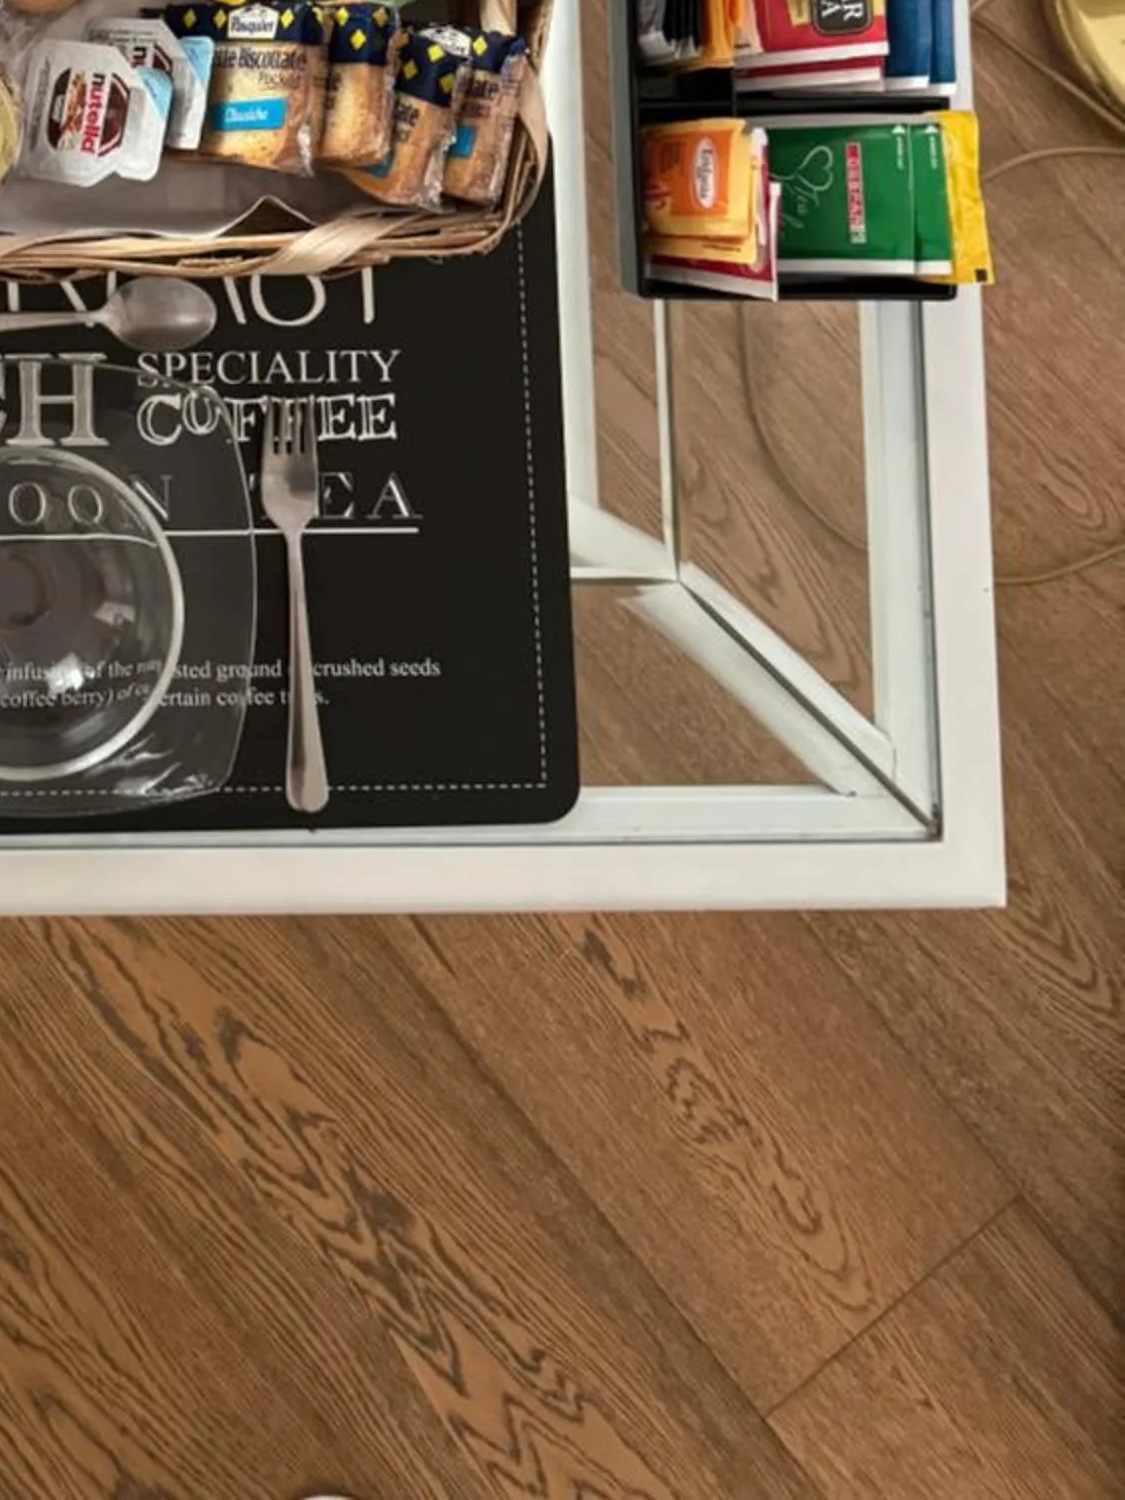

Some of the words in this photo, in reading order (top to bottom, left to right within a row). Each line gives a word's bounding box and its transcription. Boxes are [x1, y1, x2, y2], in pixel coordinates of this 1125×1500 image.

[79, 72, 106, 154] nutella
[137, 349, 402, 389] SPECIALITY
[108, 659, 134, 678] the
[389, 658, 442, 677] seeds
[215, 686, 275, 706] cofee
